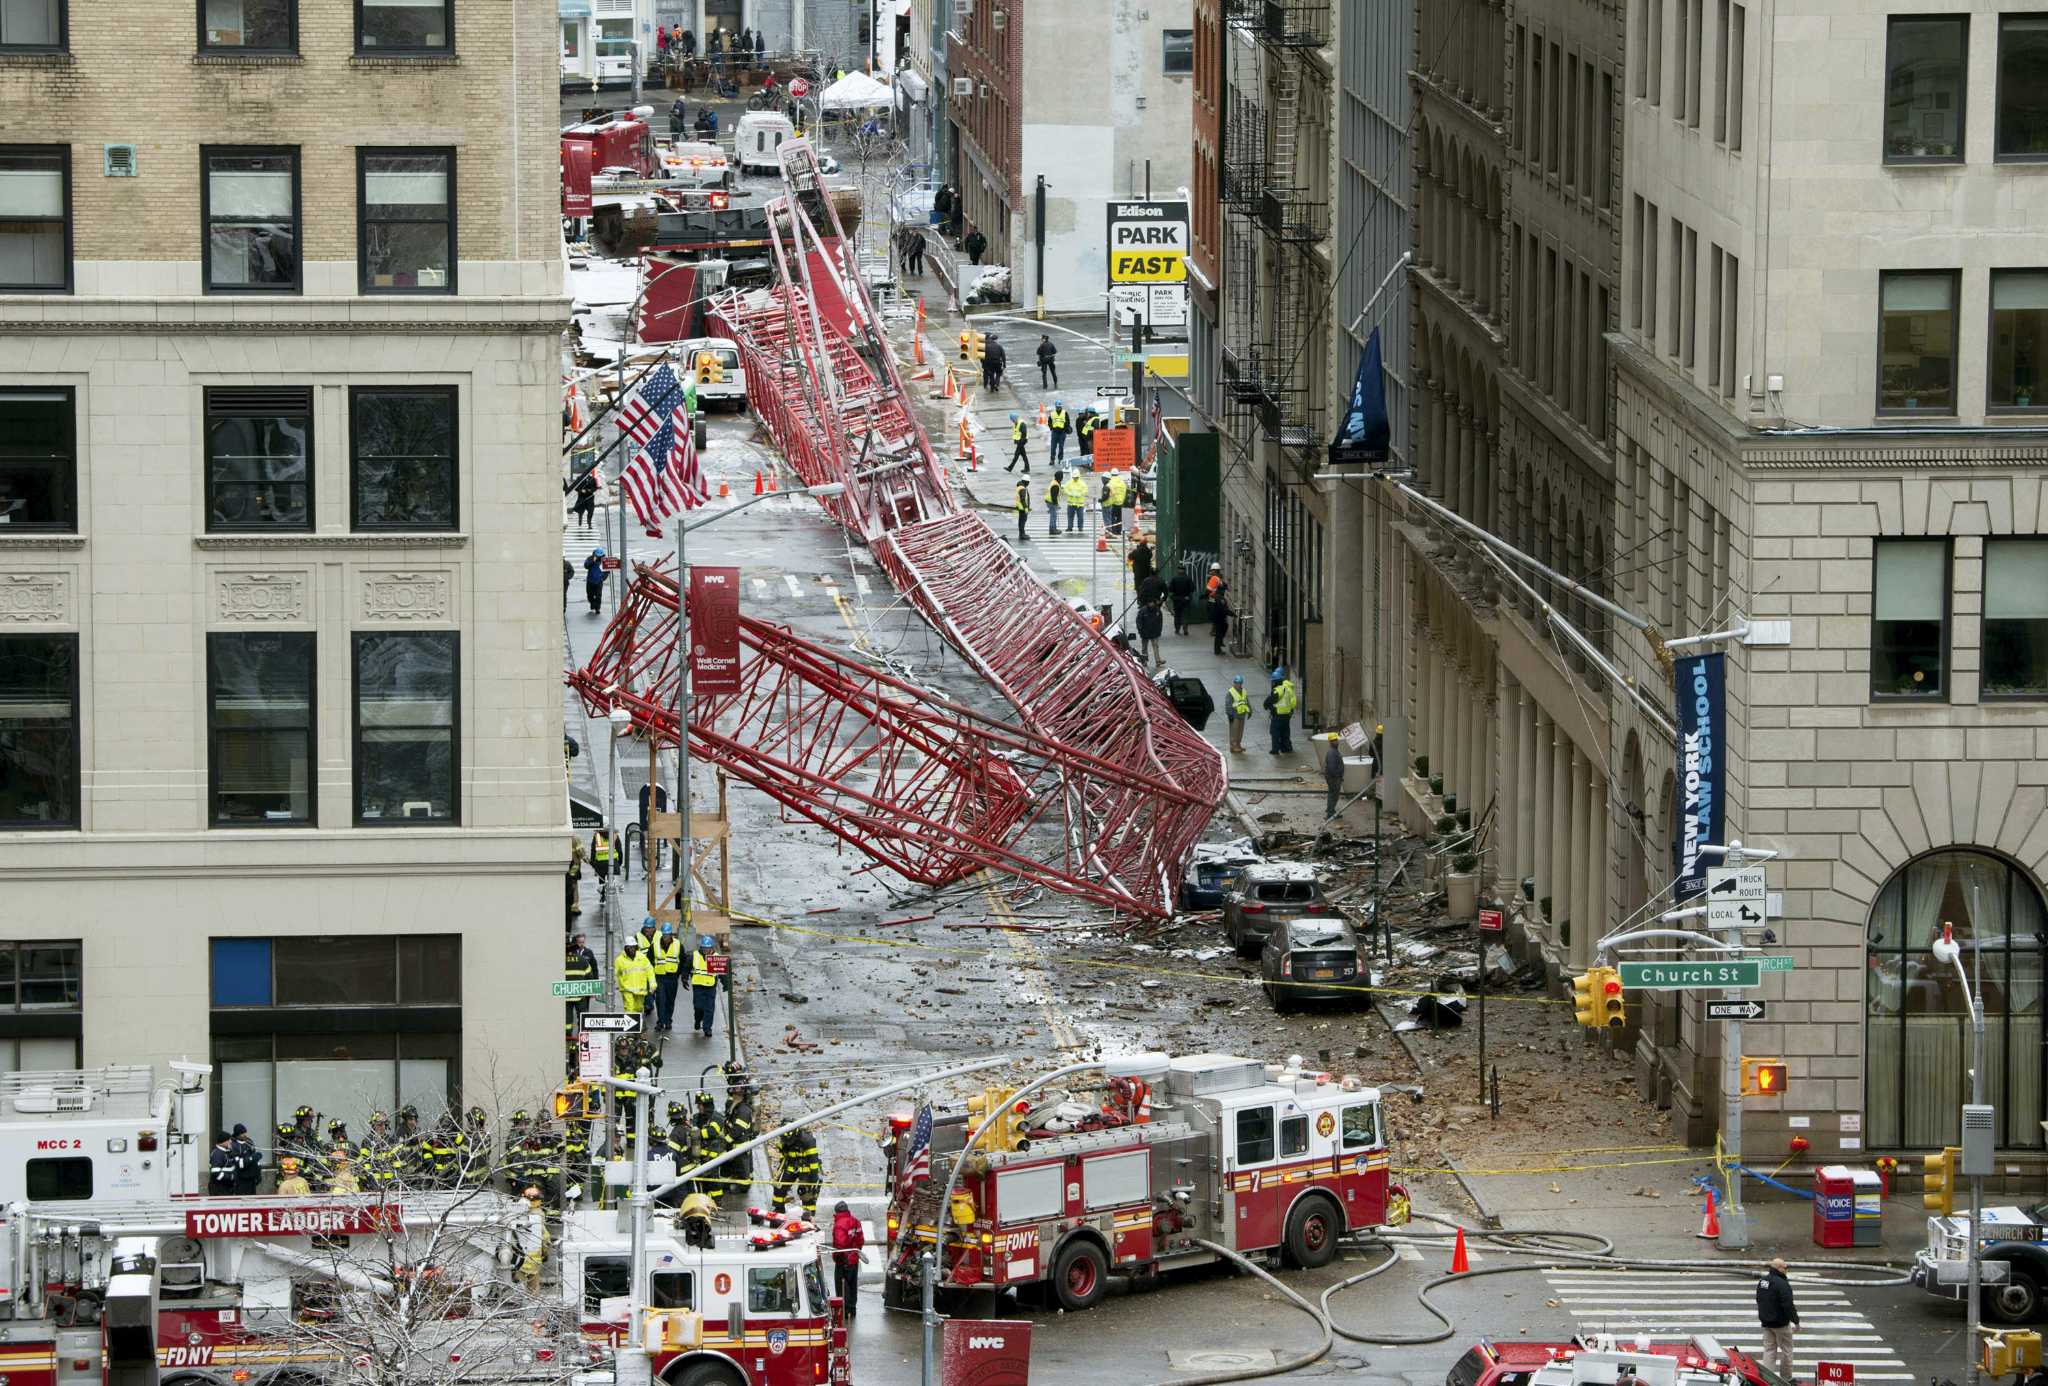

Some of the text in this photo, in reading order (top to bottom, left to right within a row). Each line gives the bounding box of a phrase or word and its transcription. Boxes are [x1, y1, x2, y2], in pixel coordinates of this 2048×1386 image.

[792, 84, 806, 92] STOP
[1117, 205, 1163, 217] Edison
[1118, 227, 1178, 244] PARK
[1118, 257, 1177, 275] FAST
[704, 575, 725, 584] NYC
[1693, 659, 1713, 843] LAW SCHOOL
[1682, 731, 1699, 877] NEW YORK
[1739, 875, 1763, 883] TRUCK
[1739, 888, 1763, 897] ROUTE
[1641, 968, 1739, 982] Church St
[553, 983, 594, 996] CHURCH
[589, 1018, 632, 1027] ONE WAY
[37, 1139, 81, 1150] MCC 2
[1251, 1171, 1261, 1193] 7
[1828, 1199, 1852, 1208] VOICE
[193, 1212, 264, 1234] TOWER
[268, 1210, 346, 1232] LADDER
[2028, 1226, 2040, 1240] ST
[1006, 1230, 1035, 1251] FDNY
[718, 1276, 727, 1292] 1
[969, 1336, 1005, 1349] NYC
[166, 1346, 213, 1366] FDNY
[1829, 1367, 1842, 1378] NO
